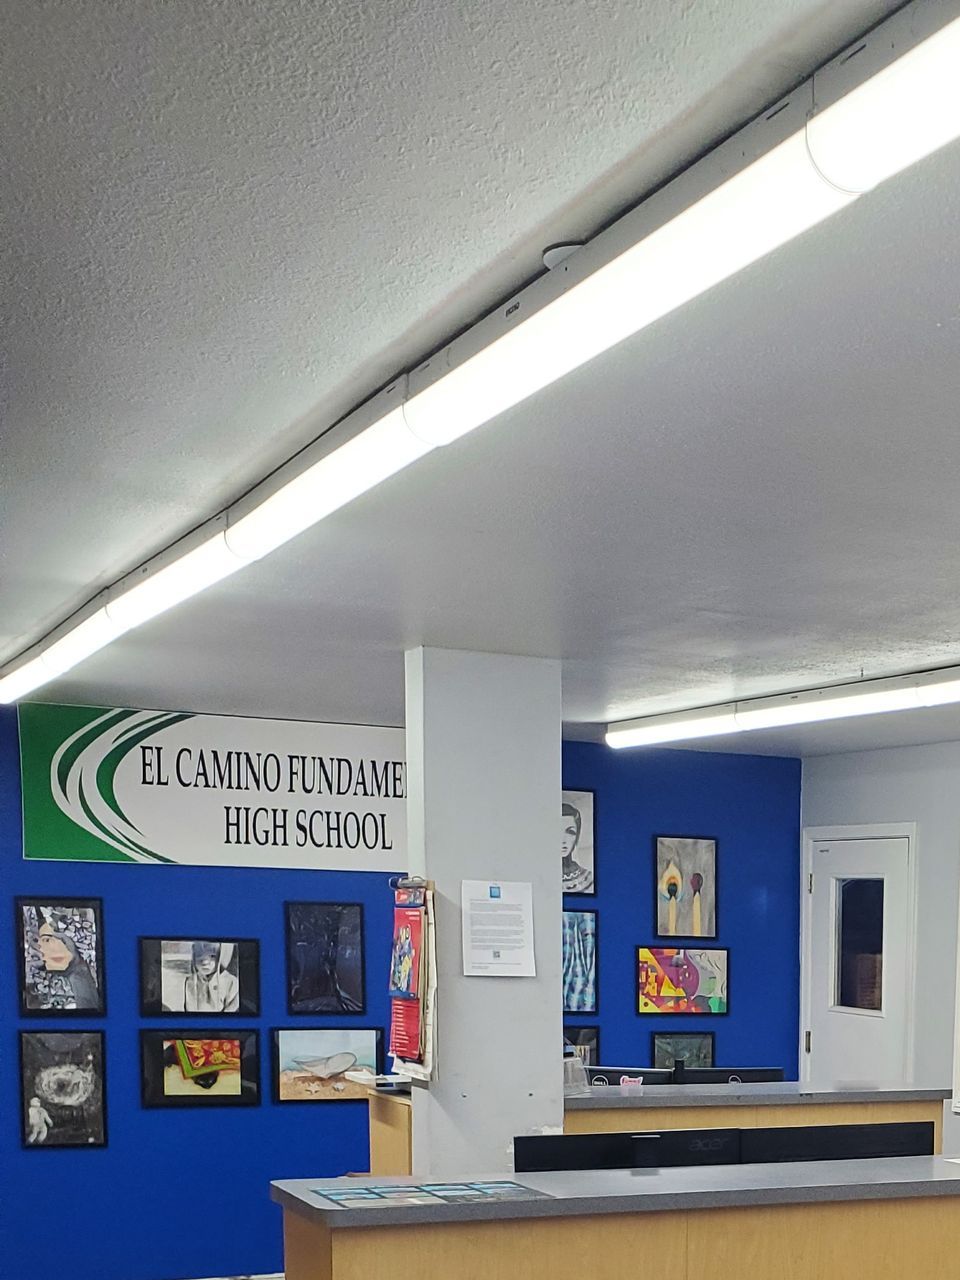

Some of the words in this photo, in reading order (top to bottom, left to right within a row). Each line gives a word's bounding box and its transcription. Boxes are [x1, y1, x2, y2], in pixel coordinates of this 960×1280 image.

[140, 746, 169, 786] EL
[176, 748, 280, 792] CAMINO
[287, 754, 407, 798] FUNDAME
[224, 806, 288, 846] HIGH
[296, 809, 392, 850] SCHOOL
